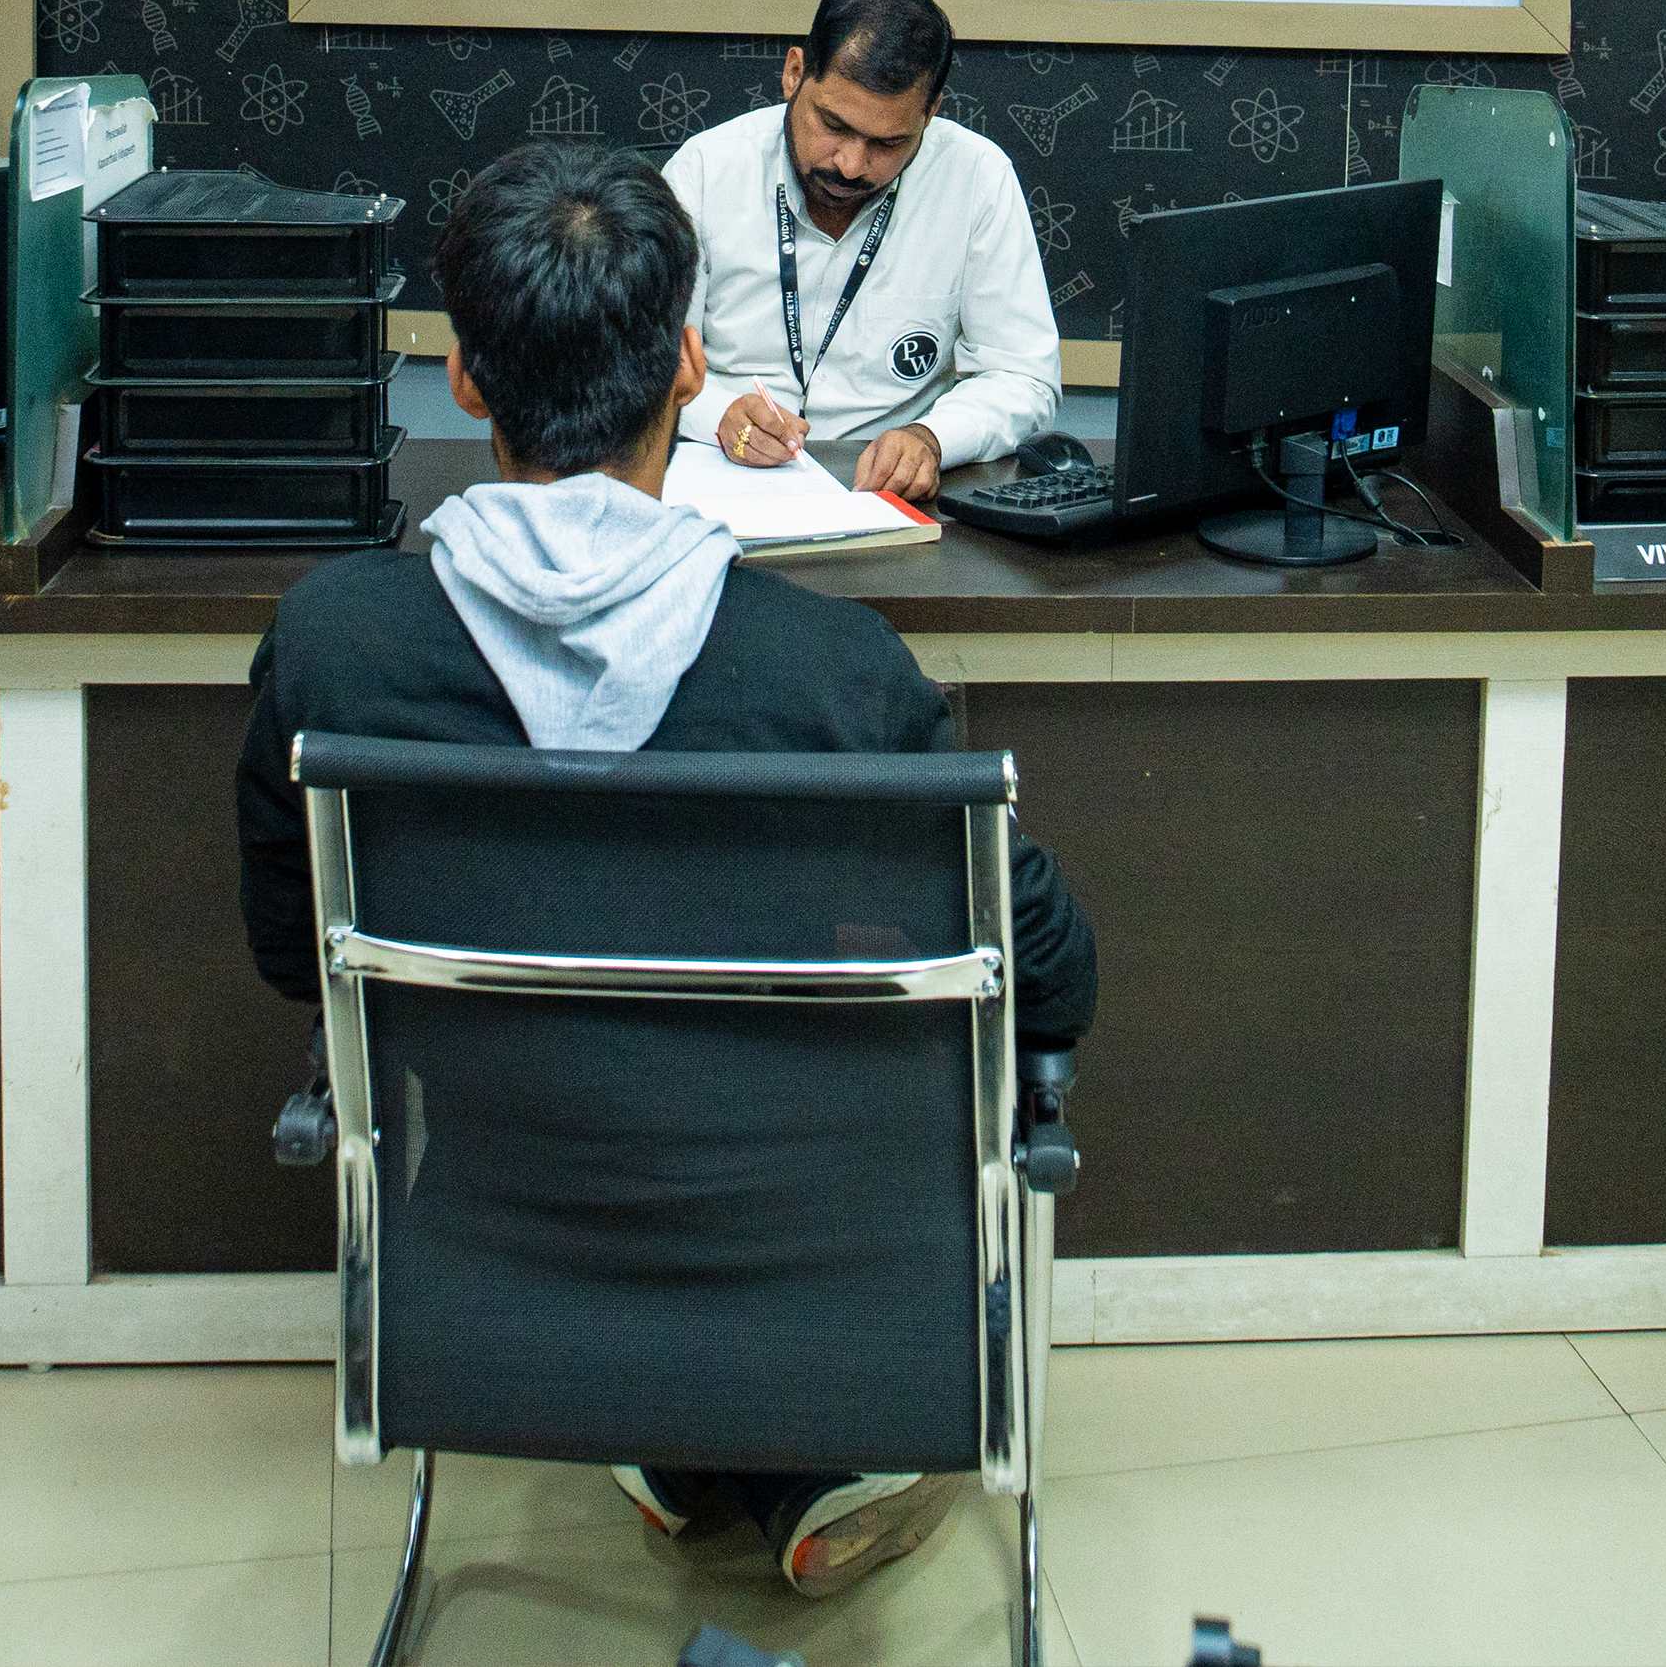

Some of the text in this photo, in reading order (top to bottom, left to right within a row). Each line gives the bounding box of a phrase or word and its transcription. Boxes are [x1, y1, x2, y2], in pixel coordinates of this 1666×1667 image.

[863, 199, 890, 251] VIDYAPEETH
[786, 291, 798, 348] VIDYAPEETH
[821, 298, 847, 351] VIDYAPEETH
